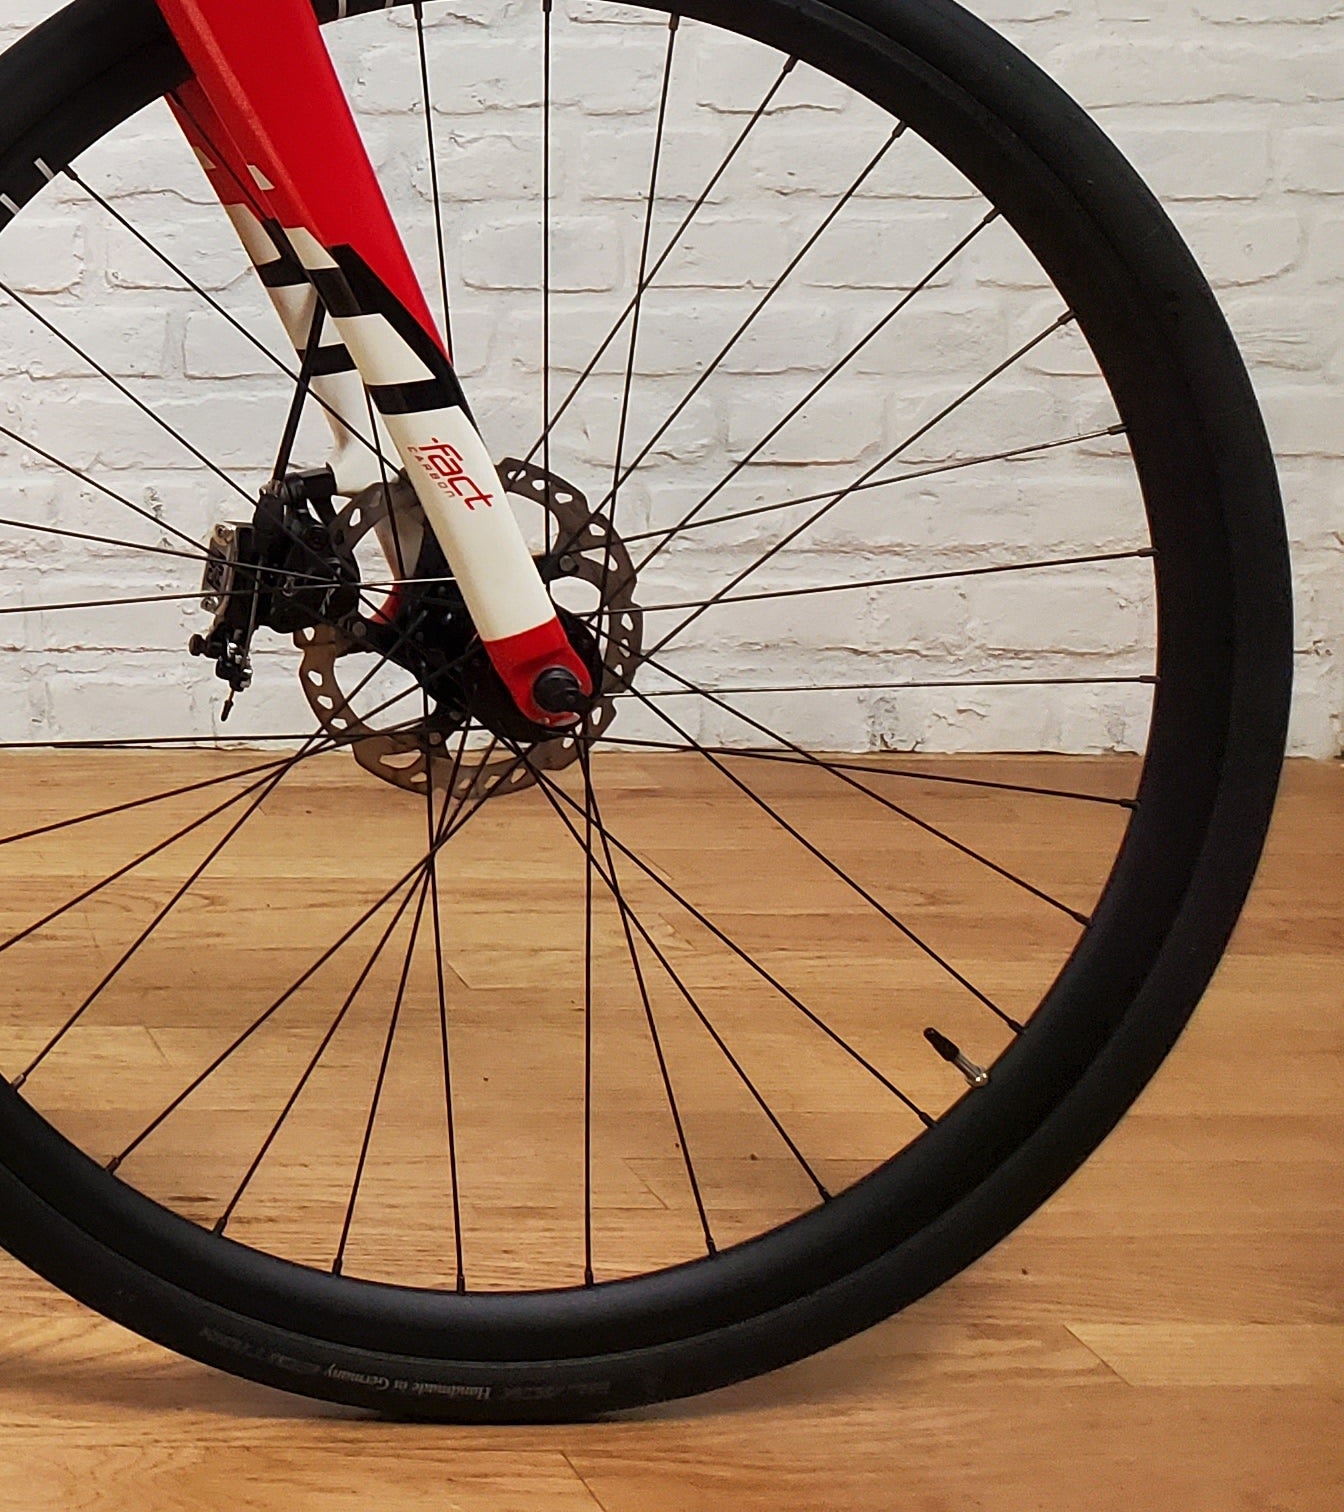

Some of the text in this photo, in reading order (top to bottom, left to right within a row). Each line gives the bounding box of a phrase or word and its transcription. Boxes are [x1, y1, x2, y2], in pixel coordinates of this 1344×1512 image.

[322, 1362, 390, 1390] Germany
[395, 1377, 409, 1390] in
[411, 1381, 492, 1400] Handmade
